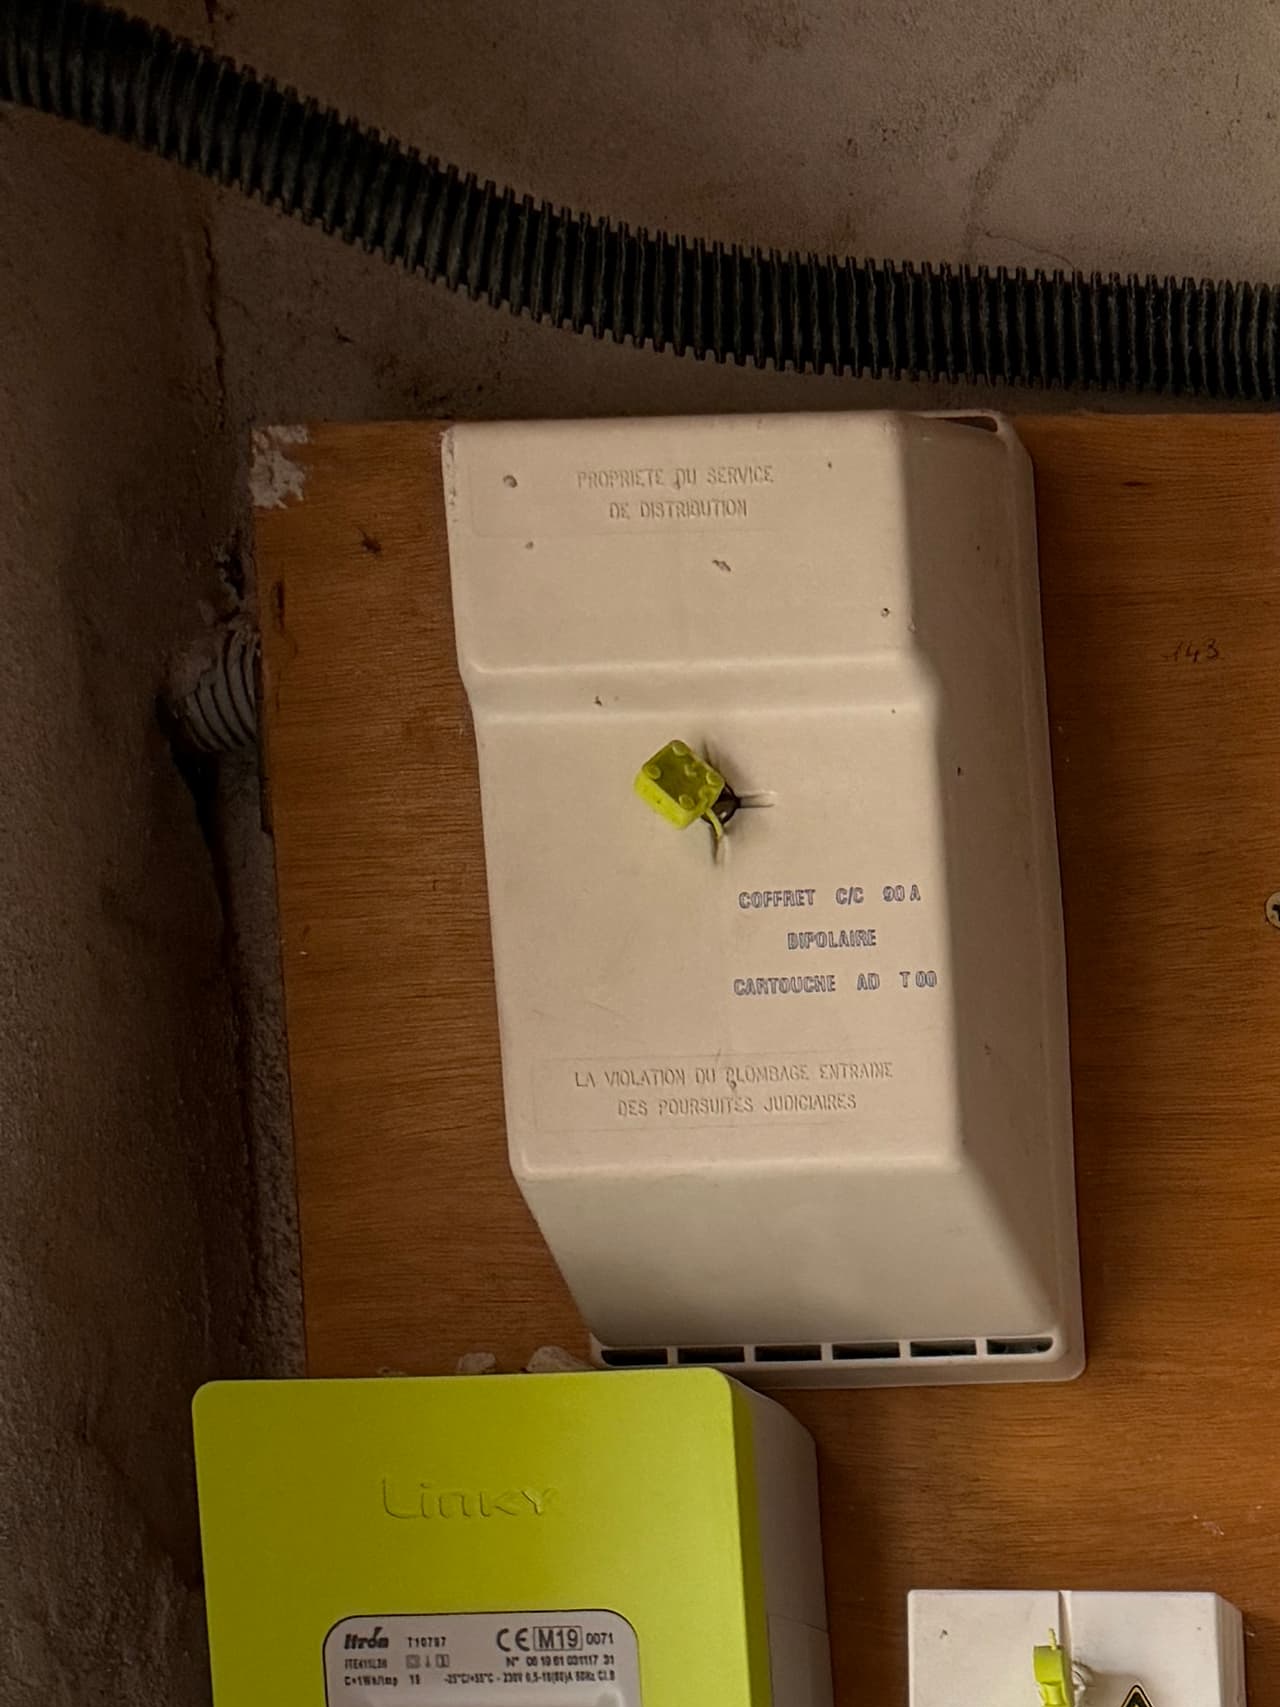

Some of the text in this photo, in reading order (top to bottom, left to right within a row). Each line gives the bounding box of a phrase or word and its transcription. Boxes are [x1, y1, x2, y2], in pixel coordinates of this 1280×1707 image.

[707, 465, 774, 484] SERVICE
[609, 499, 747, 519] DE DISTRIBUTION
[738, 888, 816, 909] COFFRET
[835, 887, 865, 906] C/C
[574, 1071, 596, 1088] LA
[604, 1067, 687, 1087] VIOLATION
[695, 1066, 716, 1085] DU
[819, 1061, 894, 1081] ENTRAINE
[617, 1093, 857, 1117] DES POURSUITES JUDICIAIRES
[538, 1628, 579, 1649] M19
[585, 1632, 615, 1645] 0071
